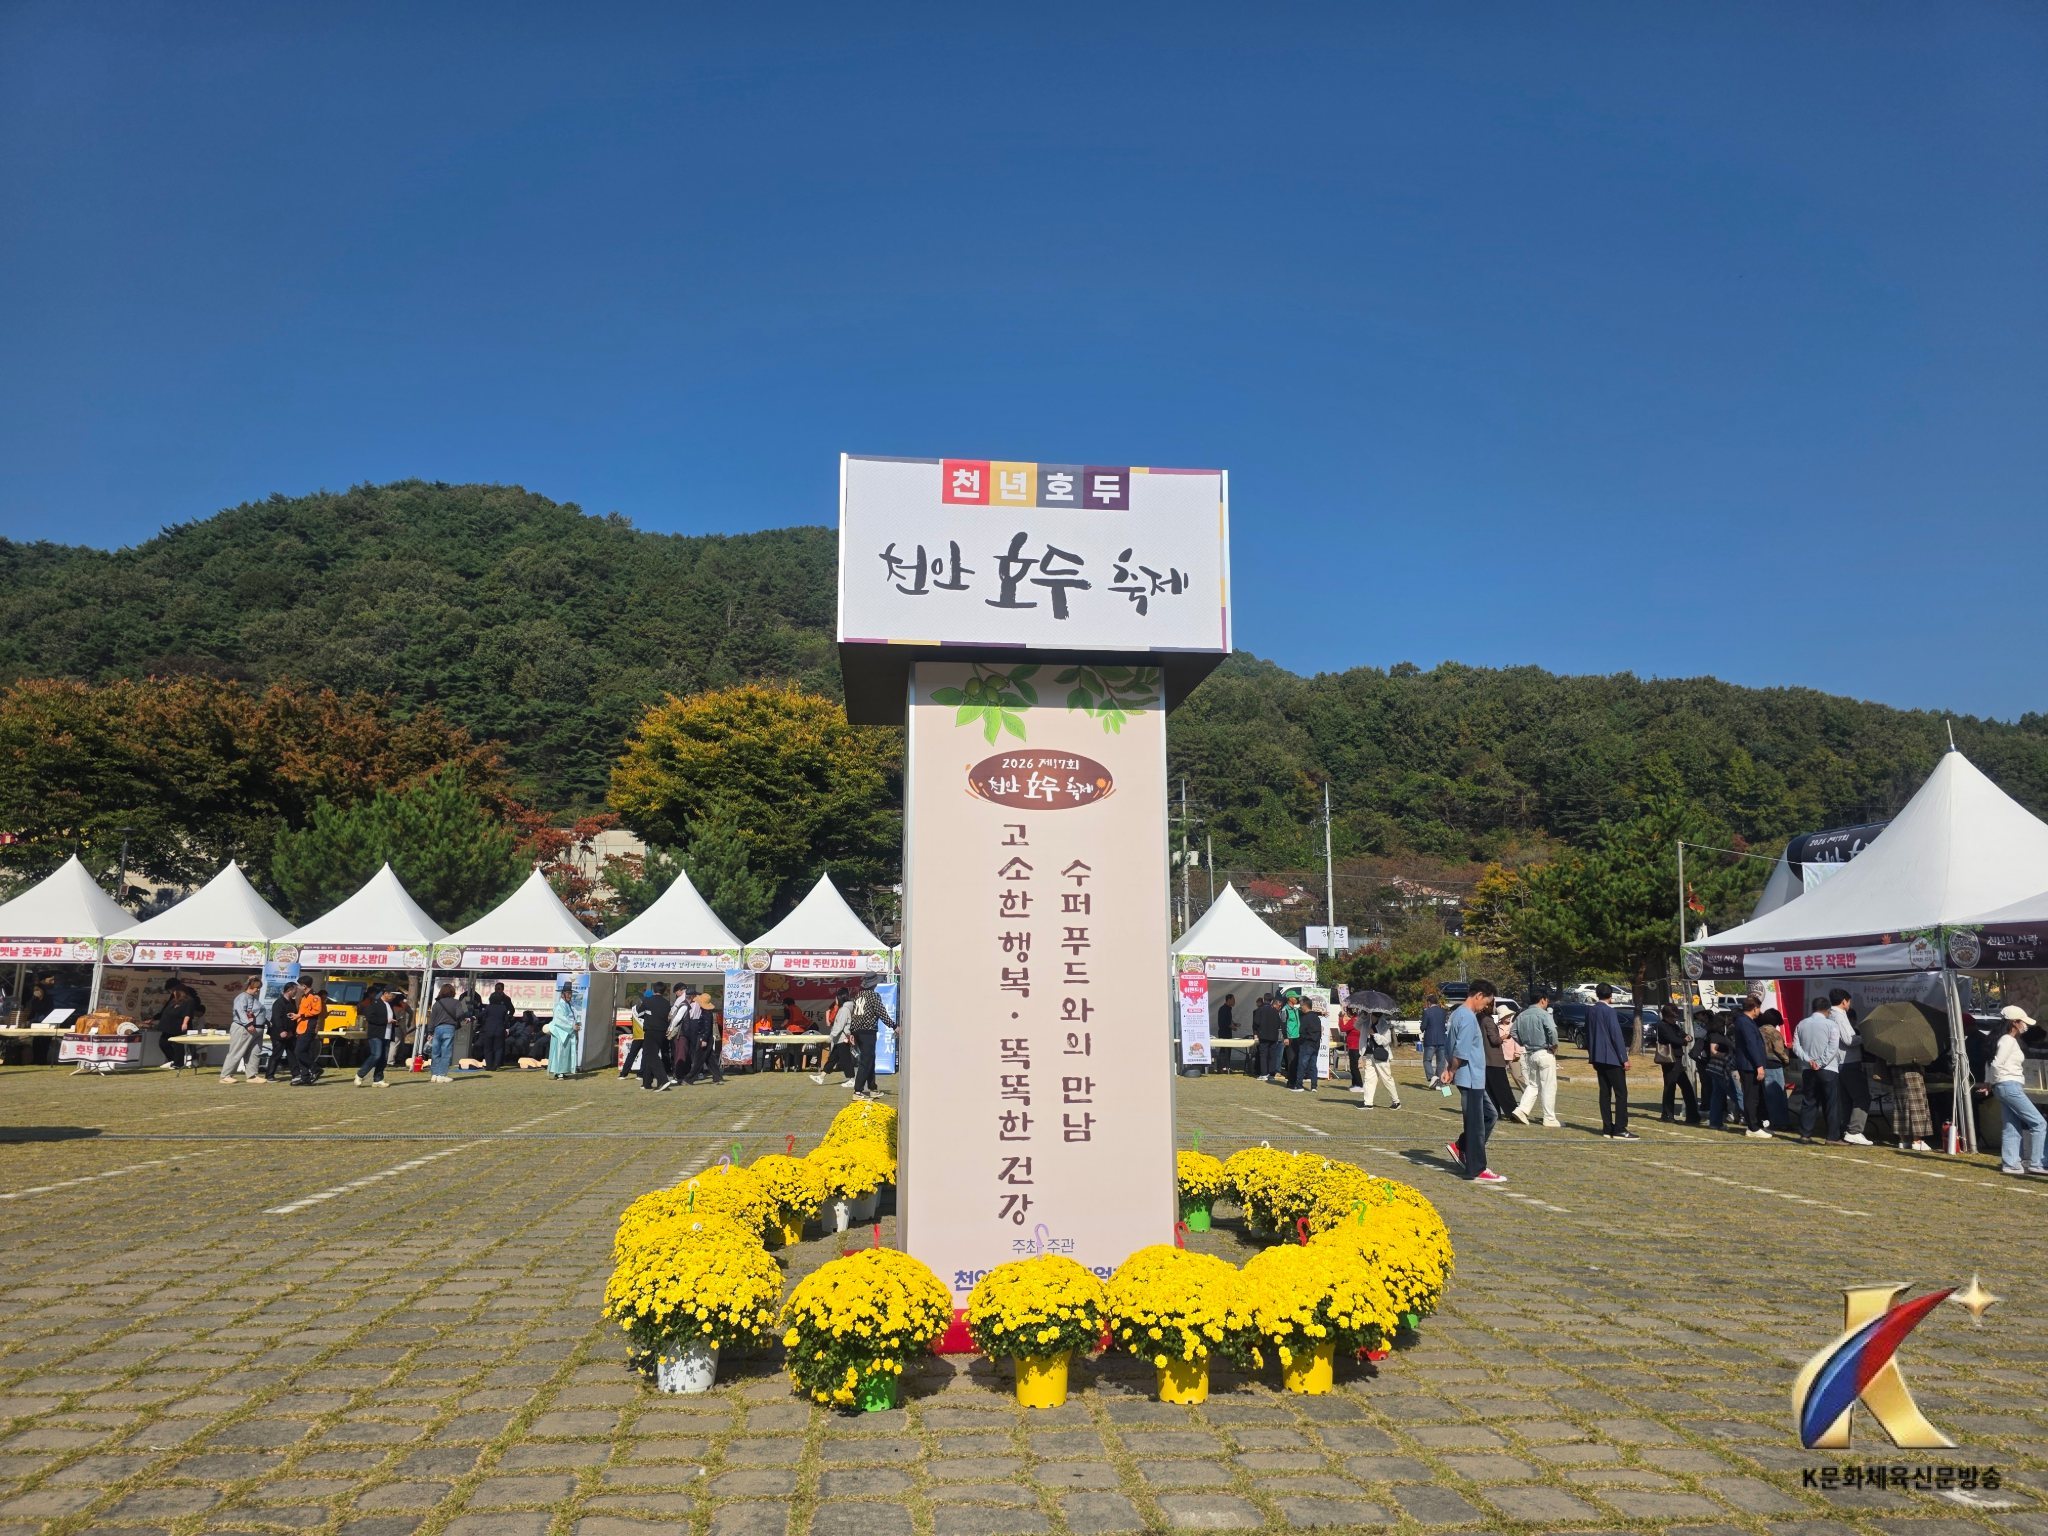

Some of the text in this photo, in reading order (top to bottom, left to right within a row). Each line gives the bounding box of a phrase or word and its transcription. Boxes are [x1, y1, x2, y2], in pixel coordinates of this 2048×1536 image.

[879, 540, 976, 596] 천안
[1107, 547, 1190, 616] 축제
[1002, 758, 1080, 771] 2026 제17회
[987, 774, 1022, 796] 천안
[1065, 776, 1094, 801] 축제
[22, 946, 63, 958] 호두과자
[163, 950, 216, 962] 호두 역사관
[1997, 949, 2036, 961] 천안 호두
[318, 953, 388, 965] 광덕 의용소방대
[480, 954, 548, 967] 광덕 의용소방대
[783, 957, 857, 969] 광덕면 주민자치회
[1783, 952, 1857, 972] 명품 호두 작목반
[1242, 966, 1261, 977] 안내
[1060, 858, 1097, 1143] 수퍼푸드와의 만남
[998, 823, 1035, 1226] 고소한 행복 똑똑한 건강
[76, 1044, 129, 1058] 호두 역사관
